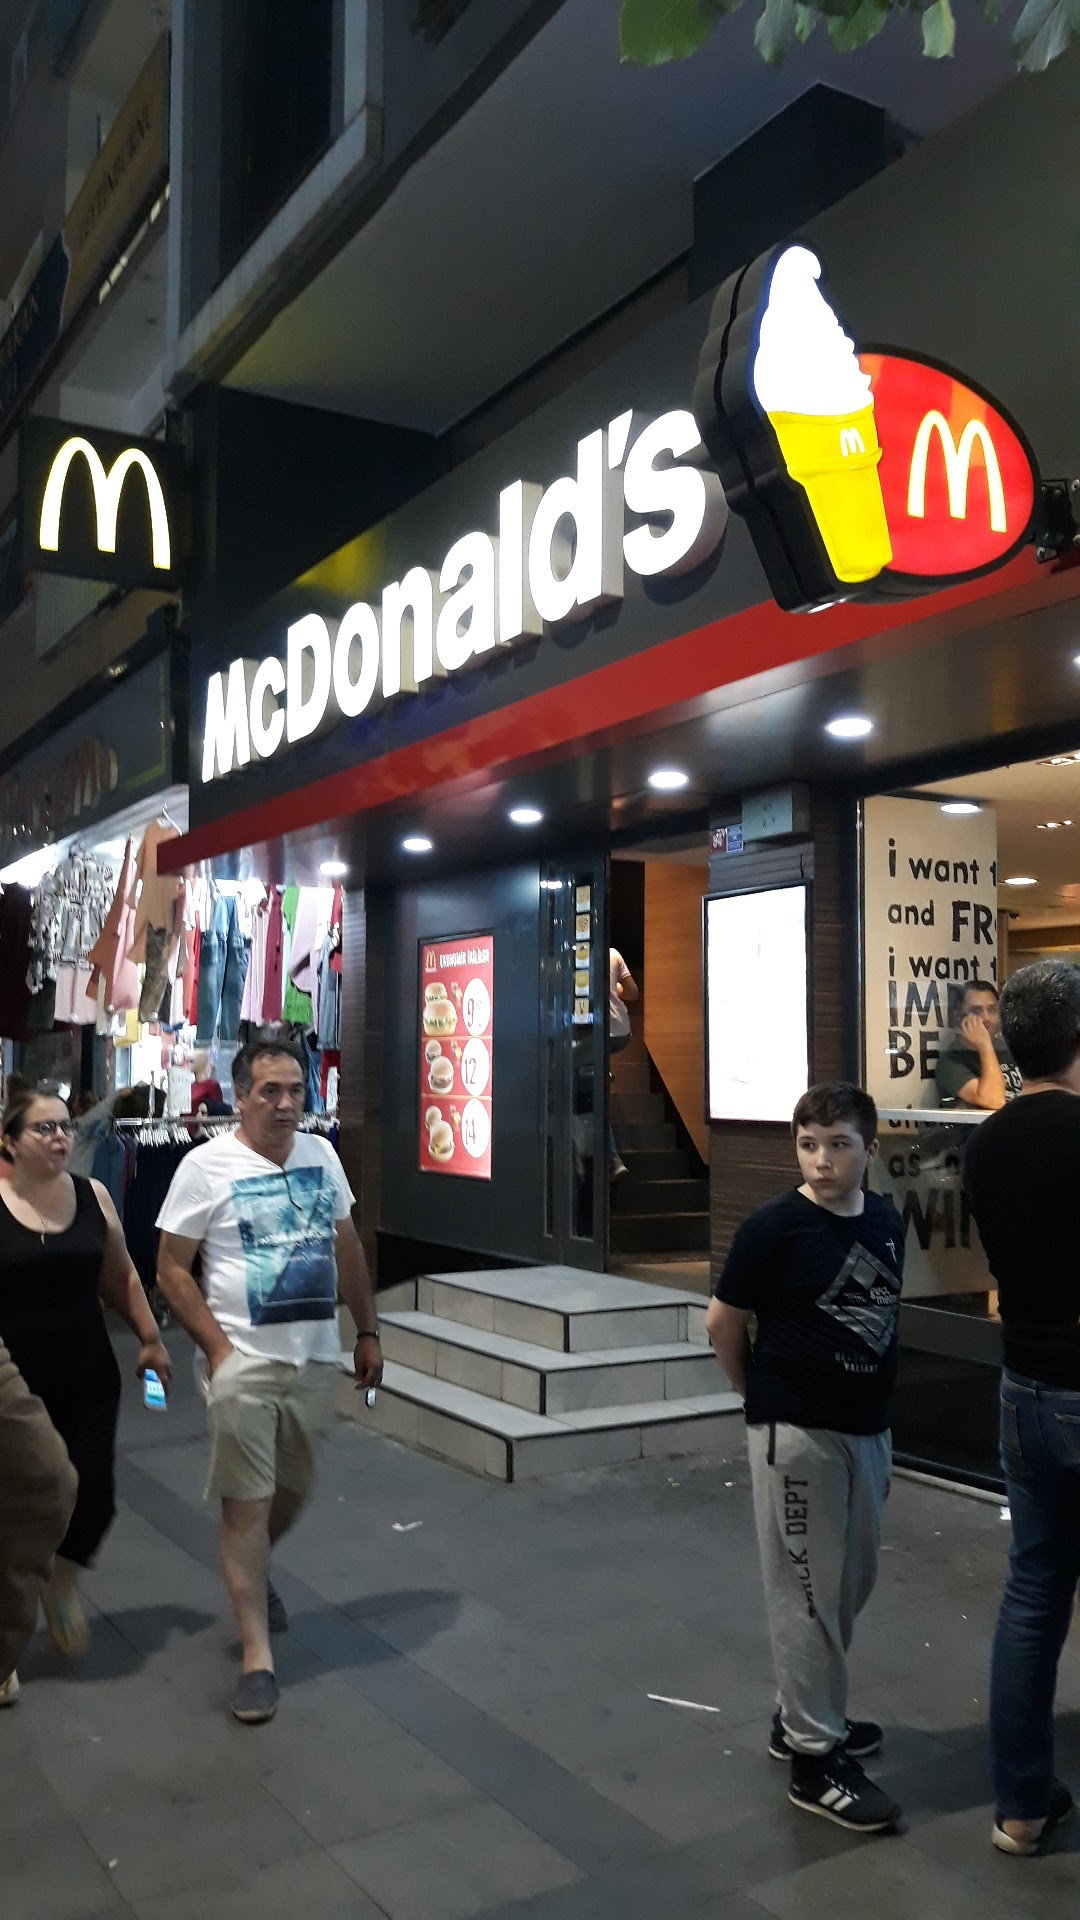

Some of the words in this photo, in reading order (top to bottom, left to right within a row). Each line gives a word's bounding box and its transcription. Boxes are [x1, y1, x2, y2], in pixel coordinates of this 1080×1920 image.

[201, 409, 706, 784] McDonald's
[888, 837, 896, 878] i
[909, 857, 980, 886] want
[888, 899, 935, 926] and
[951, 899, 997, 945] FR
[888, 947, 895, 977] i
[909, 955, 979, 981] want
[464, 1057, 477, 1085] 12
[465, 1118, 476, 1146] 14
[784, 1475, 808, 1536] DEPT
